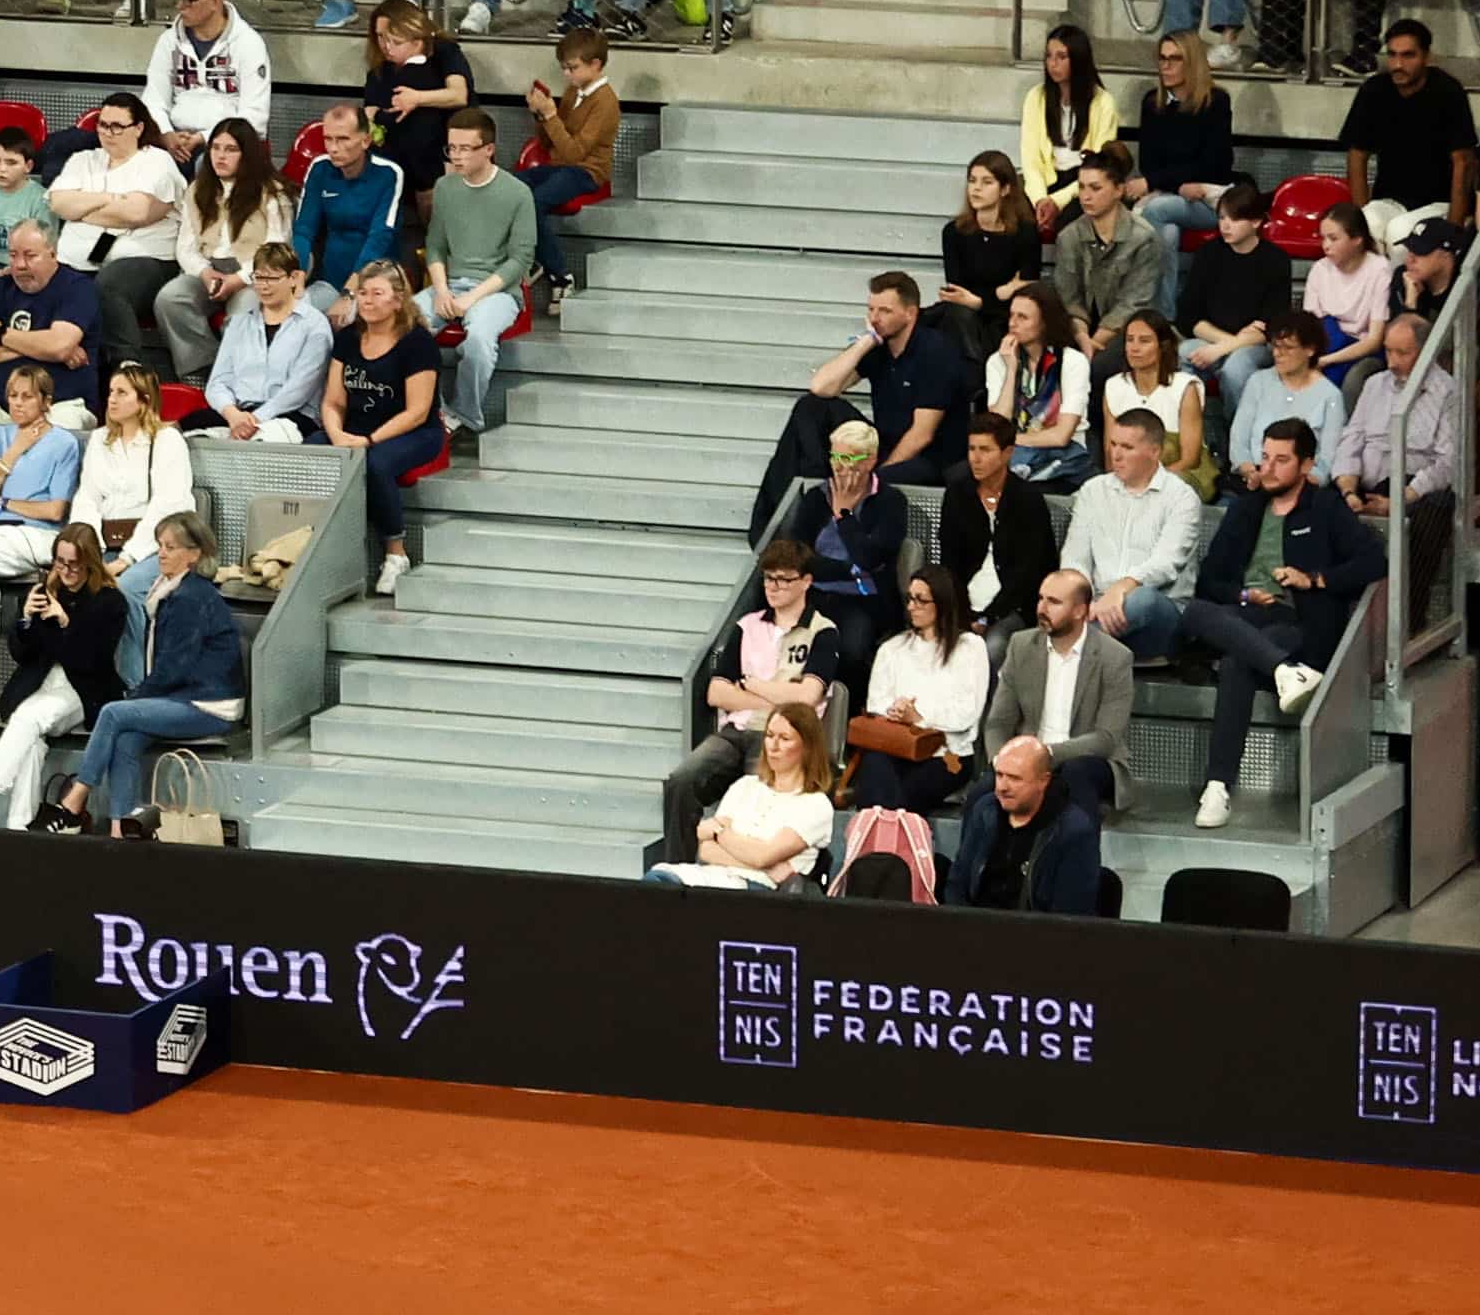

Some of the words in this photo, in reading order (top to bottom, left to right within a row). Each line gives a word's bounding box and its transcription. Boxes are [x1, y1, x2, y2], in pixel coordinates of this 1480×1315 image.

[788, 644, 808, 664] 10
[94, 913, 334, 1003] Rouen
[732, 960, 781, 995] TEN
[734, 1016, 782, 1048] NIS
[813, 1013, 1093, 1063] FRANÇAISE
[1373, 1021, 1421, 1055] TEN
[0, 1048, 66, 1083] STADIUM
[1373, 1073, 1420, 1105] NIS
